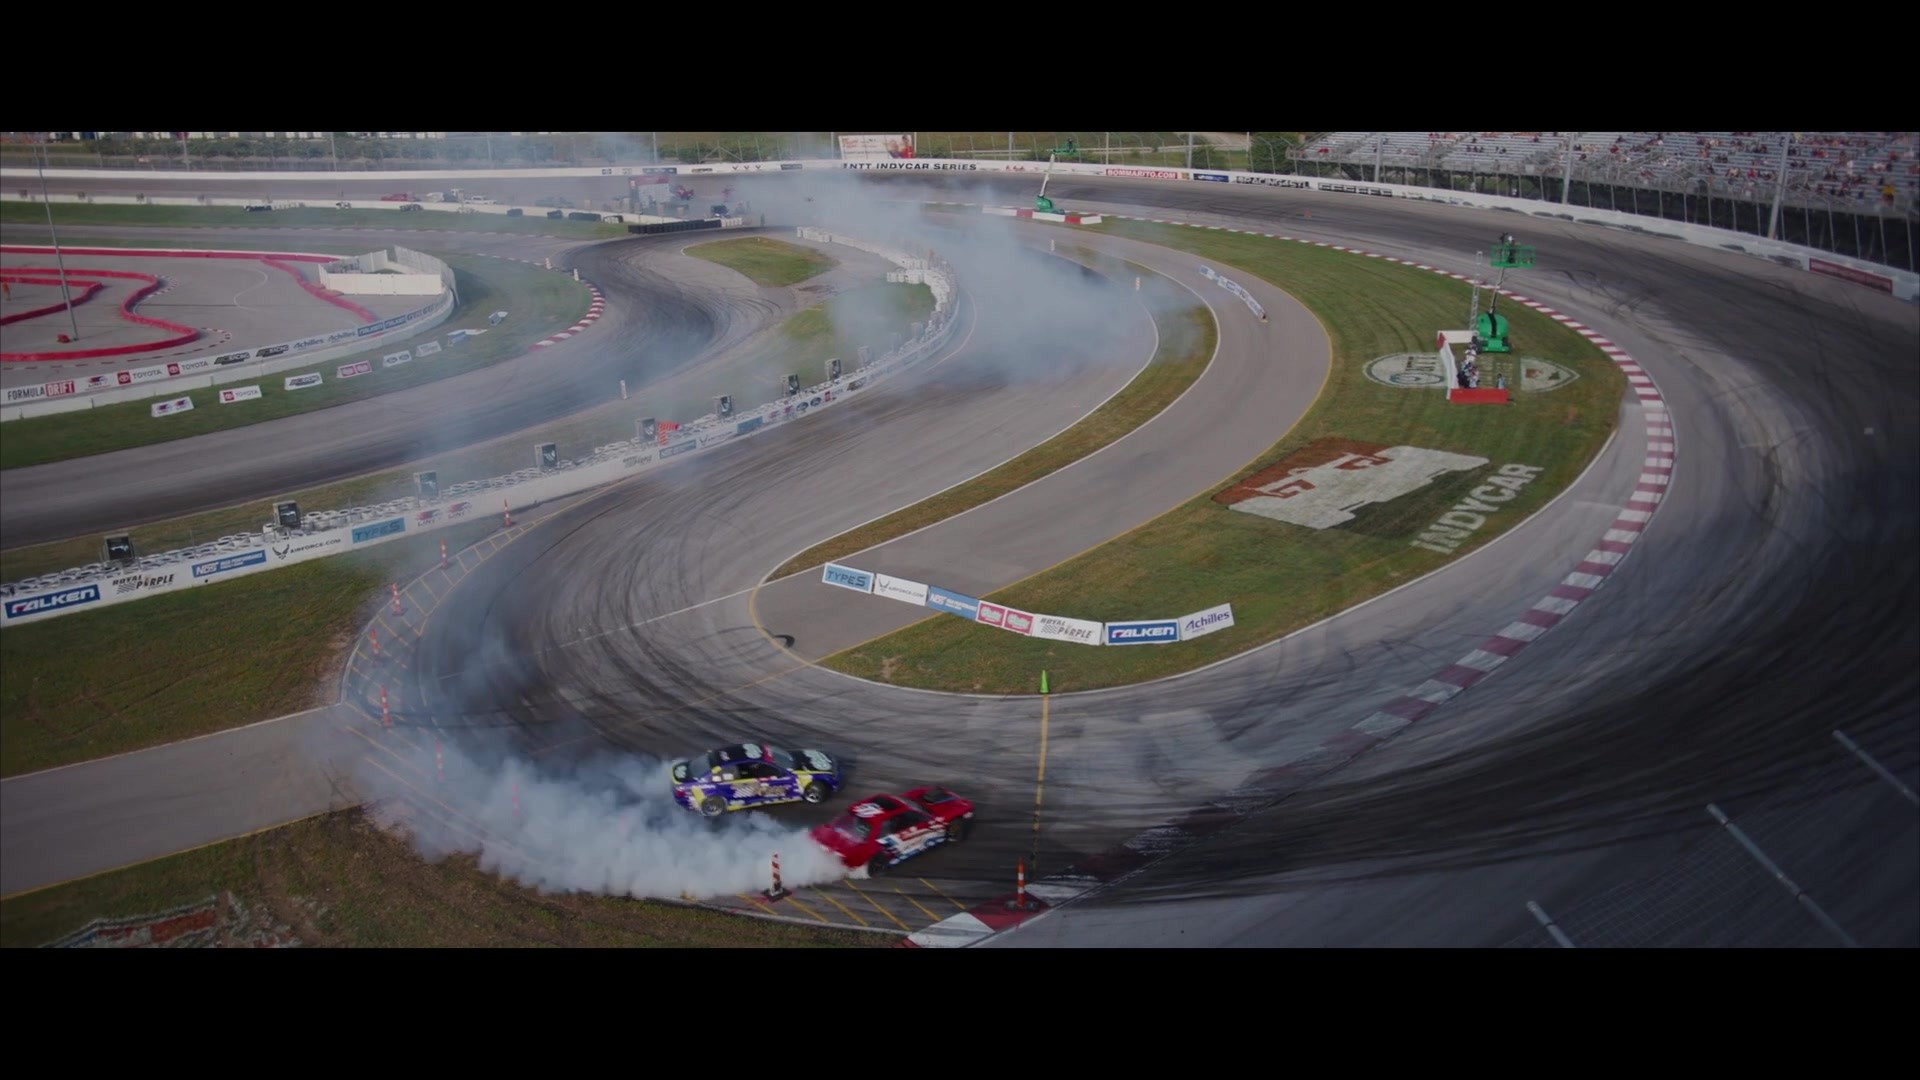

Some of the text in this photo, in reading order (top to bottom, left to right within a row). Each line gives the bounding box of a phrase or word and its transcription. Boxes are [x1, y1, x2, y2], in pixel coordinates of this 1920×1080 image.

[933, 163, 977, 171] SERIES
[1107, 169, 1176, 179] BOMMARITO.COM
[181, 361, 209, 370] TOYOTA
[133, 370, 162, 379] TOYOTA
[8, 385, 45, 401] FORMULA
[46, 382, 73, 396] DRIFT
[1408, 463, 1544, 554] INDYCAR
[290, 538, 341, 553] AIRFORCE.COM
[113, 575, 142, 586] ROYAL
[136, 574, 174, 589] PURPLE
[888, 586, 925, 598] AIRFORCE.COM
[12, 588, 96, 614] FALKEN
[1039, 617, 1066, 627] ROYAL
[1185, 612, 1230, 632] Achilles
[1058, 626, 1092, 639] PURPLE
[1112, 627, 1175, 639] FALKEN
